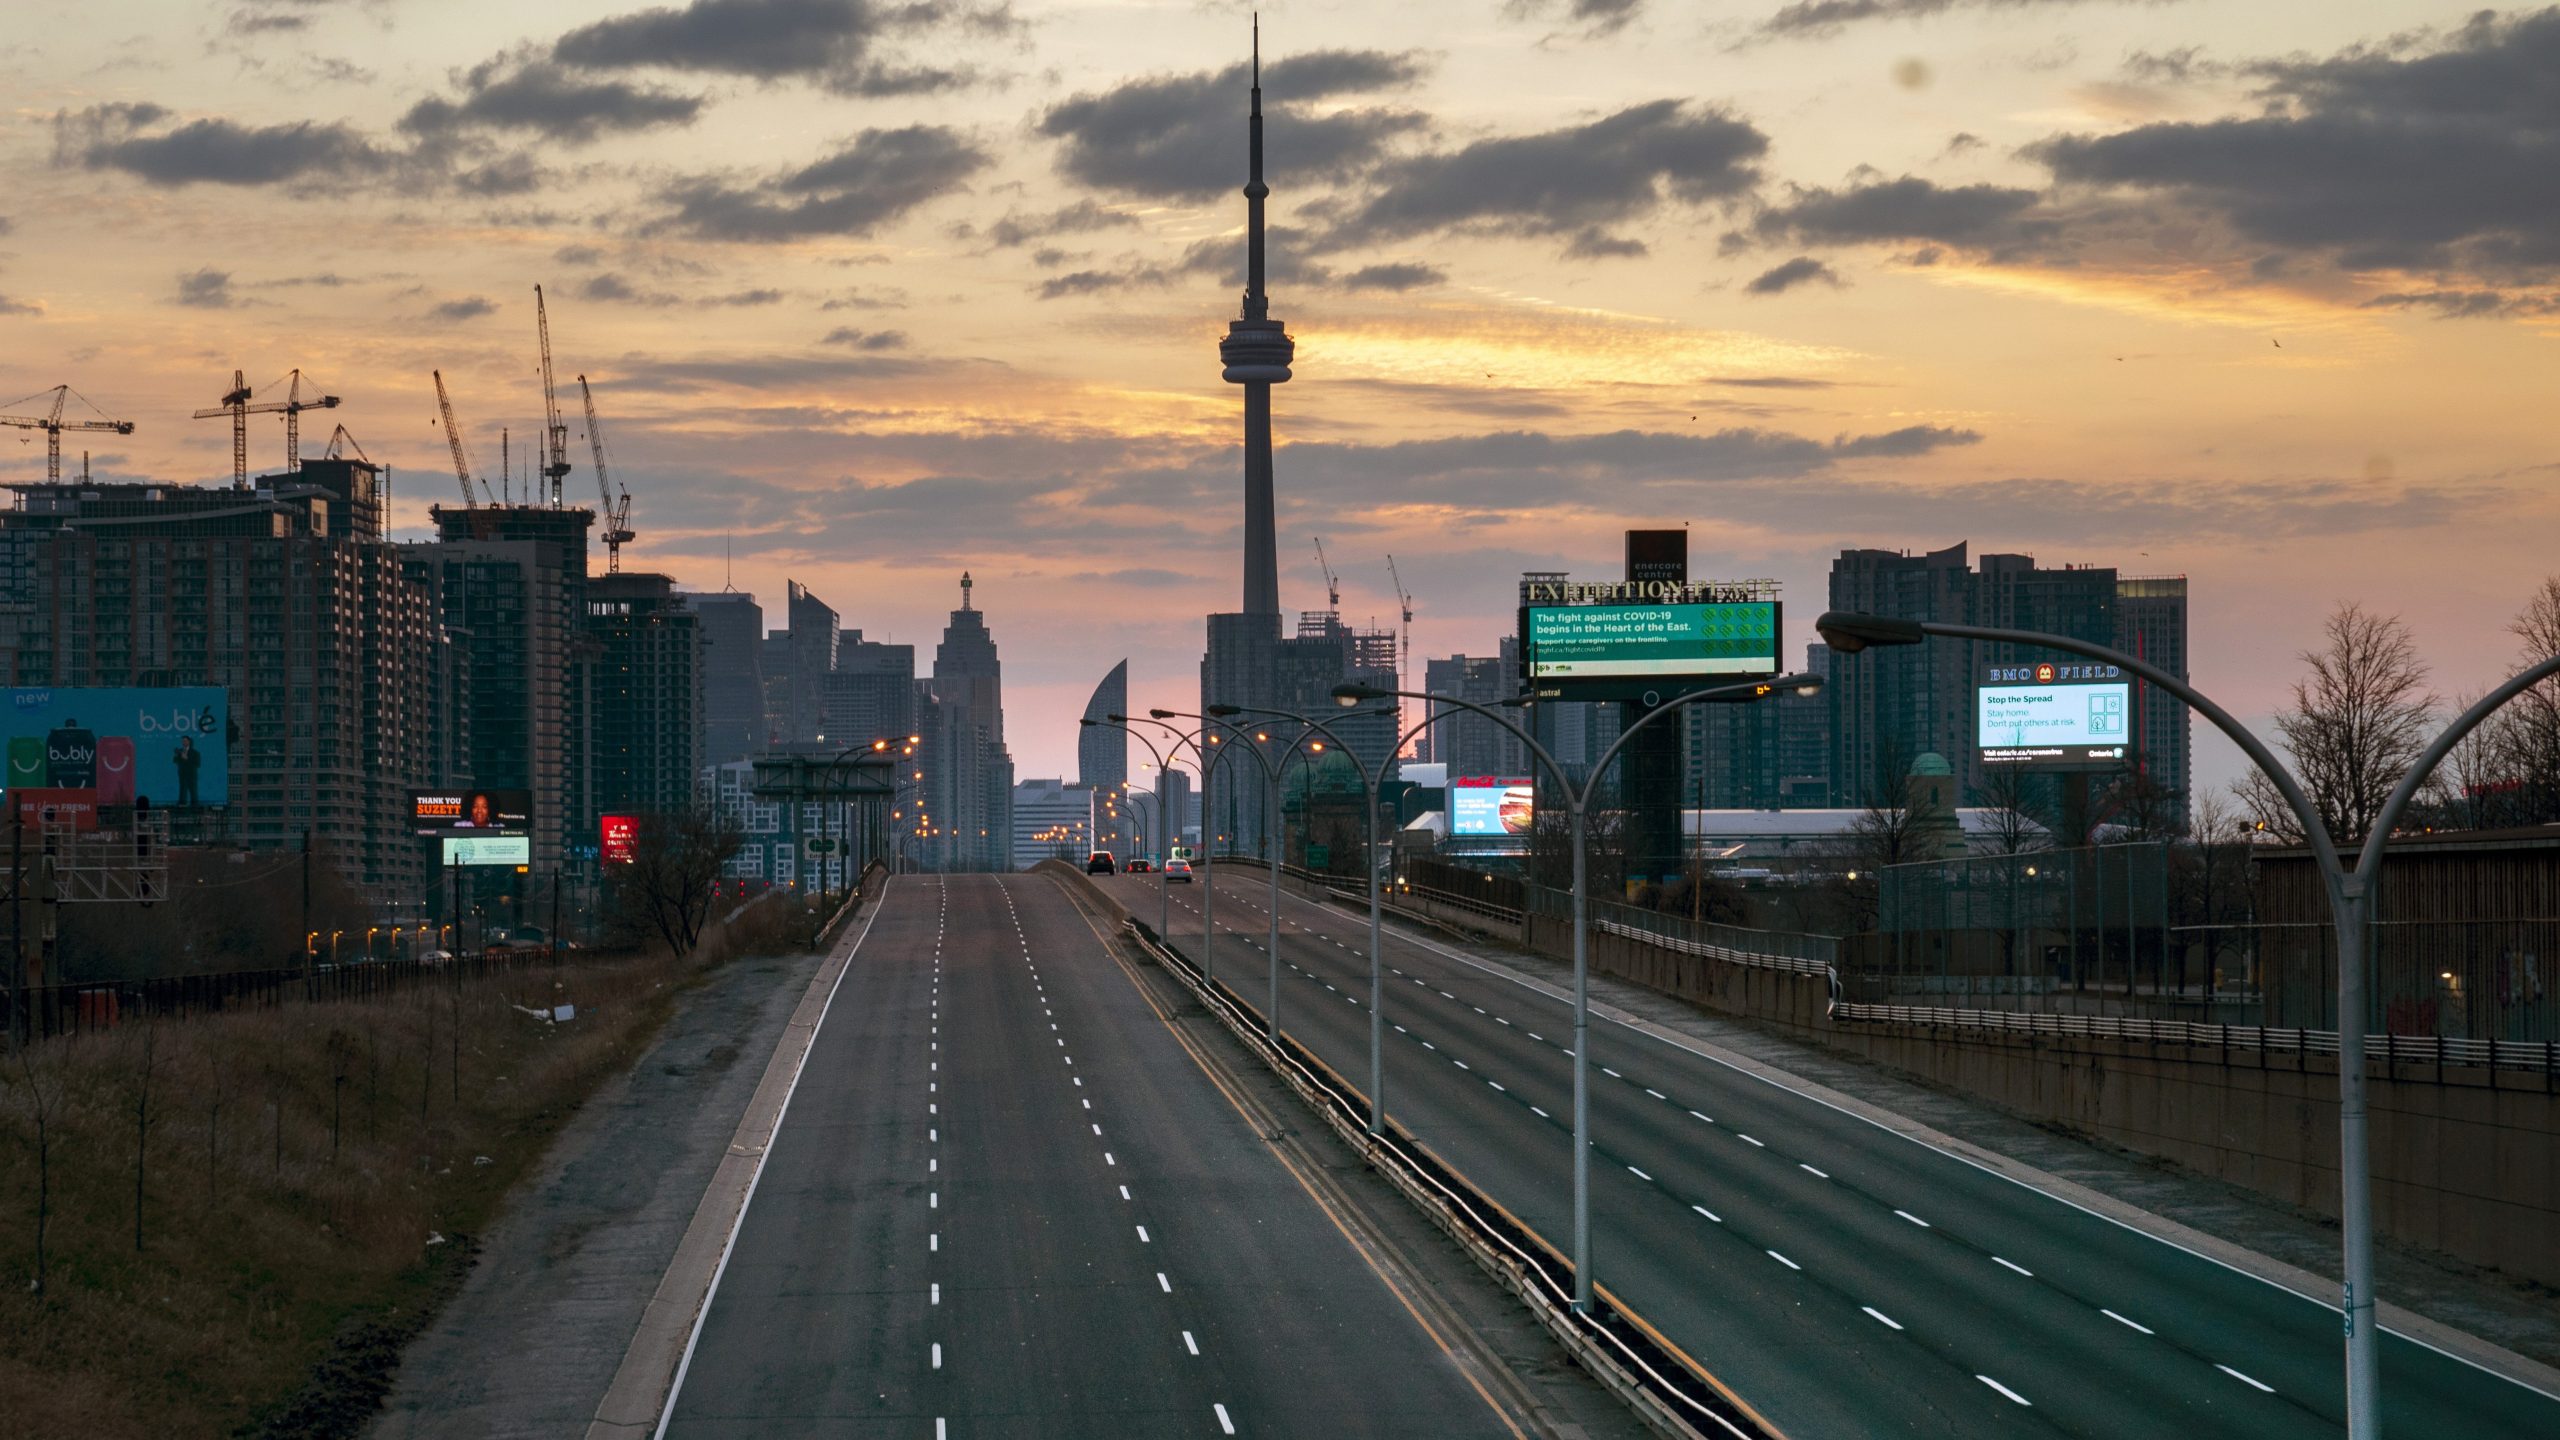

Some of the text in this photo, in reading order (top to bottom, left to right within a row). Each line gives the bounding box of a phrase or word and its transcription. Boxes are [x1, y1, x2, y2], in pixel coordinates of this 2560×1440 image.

[1637, 570, 1673, 579] centre
[1529, 578, 1774, 600] EXHIBITION PLACE
[1537, 611, 1672, 624] The fight against COVID-19
[1537, 622, 1692, 635] begins in the Heart of the East.
[1537, 638, 1563, 646] Support
[1578, 638, 1613, 646] caregivers
[1990, 665, 2119, 680] BMO FIELD
[1540, 689, 1560, 697] astral
[16, 692, 50, 705] new
[2008, 695, 2021, 703] the
[2023, 694, 2053, 704] Spread
[1988, 710, 2004, 718] Stay
[2009, 719, 2021, 729] put
[2024, 719, 2050, 727] others
[2088, 750, 2113, 758] Ontario
[416, 797, 461, 805] THANK YOU
[416, 804, 461, 815] SUZETT
